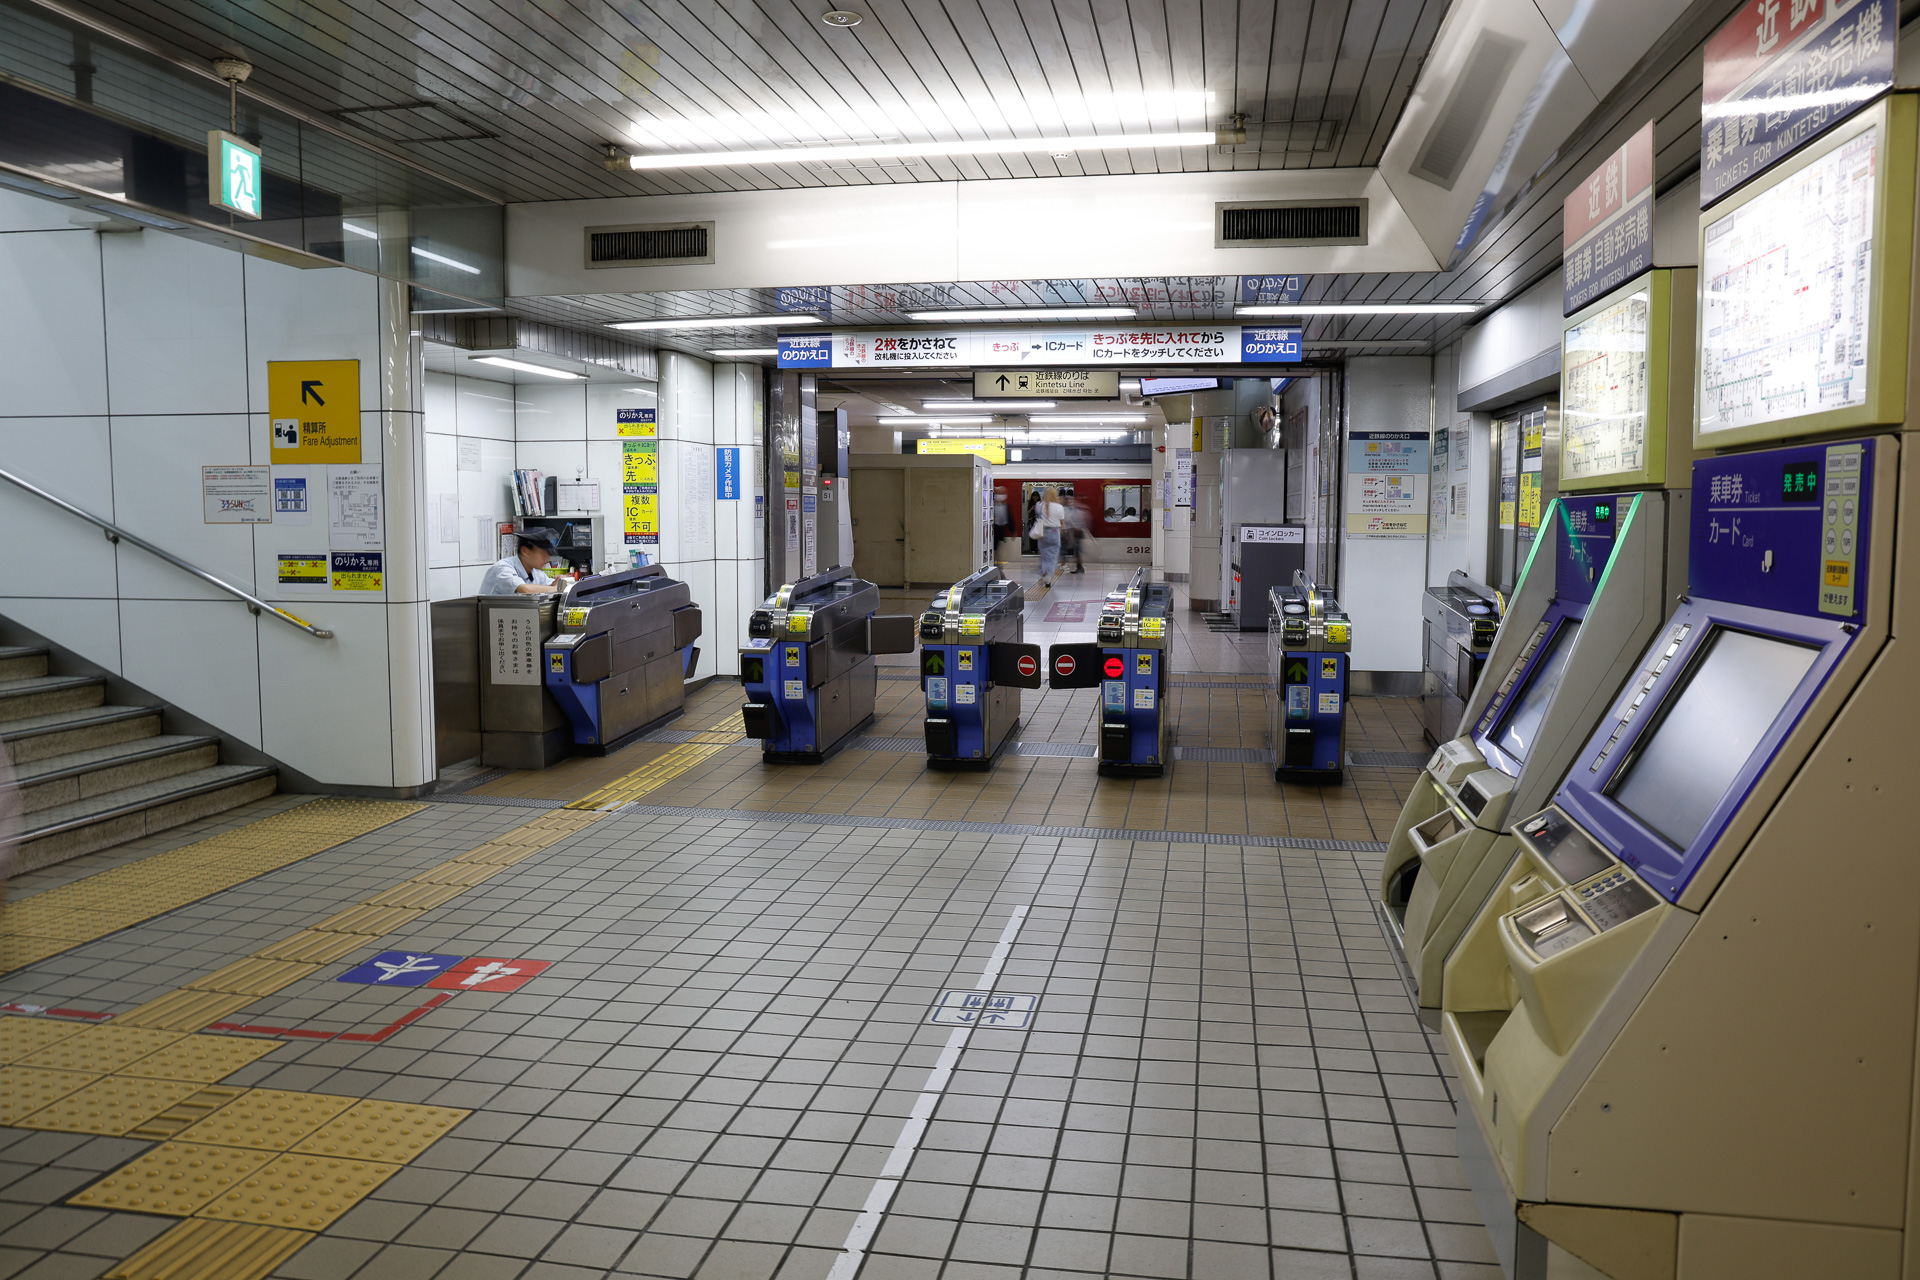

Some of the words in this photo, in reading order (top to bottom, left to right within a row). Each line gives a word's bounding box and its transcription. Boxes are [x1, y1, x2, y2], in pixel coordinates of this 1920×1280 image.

[1715, 156, 1749, 191] TICKETS
[1753, 142, 1771, 167] FOR
[1777, 107, 1828, 151] KINTETSU
[1589, 160, 1618, 222] 近鉄
[1566, 246, 1592, 290] 乗車券
[1595, 204, 1648, 274] 自動発売機
[1570, 286, 1588, 309] TICKETS
[1588, 282, 1598, 297] FOR
[1600, 266, 1624, 291] KINTETSU
[1626, 254, 1642, 277] LINES
[1093, 332, 1224, 345] きっぷを先に入れてから
[1254, 330, 1288, 341] 近鉄線
[790, 337, 820, 348] 近鉄線
[874, 337, 957, 351] 2枚をかさねて
[992, 342, 1020, 352] きっぷ
[1045, 341, 1083, 351] ICカード
[1246, 342, 1297, 354] のりかえ口
[782, 350, 828, 360] のりかえ口
[874, 352, 958, 361] 改札機に投入してください
[1093, 348, 1224, 358] ICカードをタッチしてください
[1036, 372, 1090, 380] 近鉄線のりば
[303, 422, 326, 434] 精算所
[303, 436, 318, 446] Fare
[320, 435, 358, 448] Adjustment
[625, 454, 656, 465] きっぷ
[626, 471, 636, 482] 先
[724, 449, 732, 498] 防犯カメラ作動中
[1784, 472, 1816, 493] 発売中
[1710, 474, 1742, 504] 乗車券
[1745, 491, 1760, 503] Ticket
[631, 495, 650, 505] 複数
[627, 507, 638, 516] IC
[631, 522, 651, 531] 不可
[1709, 517, 1740, 545] カード
[1742, 534, 1754, 548] Card
[1569, 541, 1586, 562] カード
[335, 557, 379, 566] のりかえ専用
[1824, 593, 1848, 606] が使えます
[498, 618, 506, 673] 係員までお申し出ください
